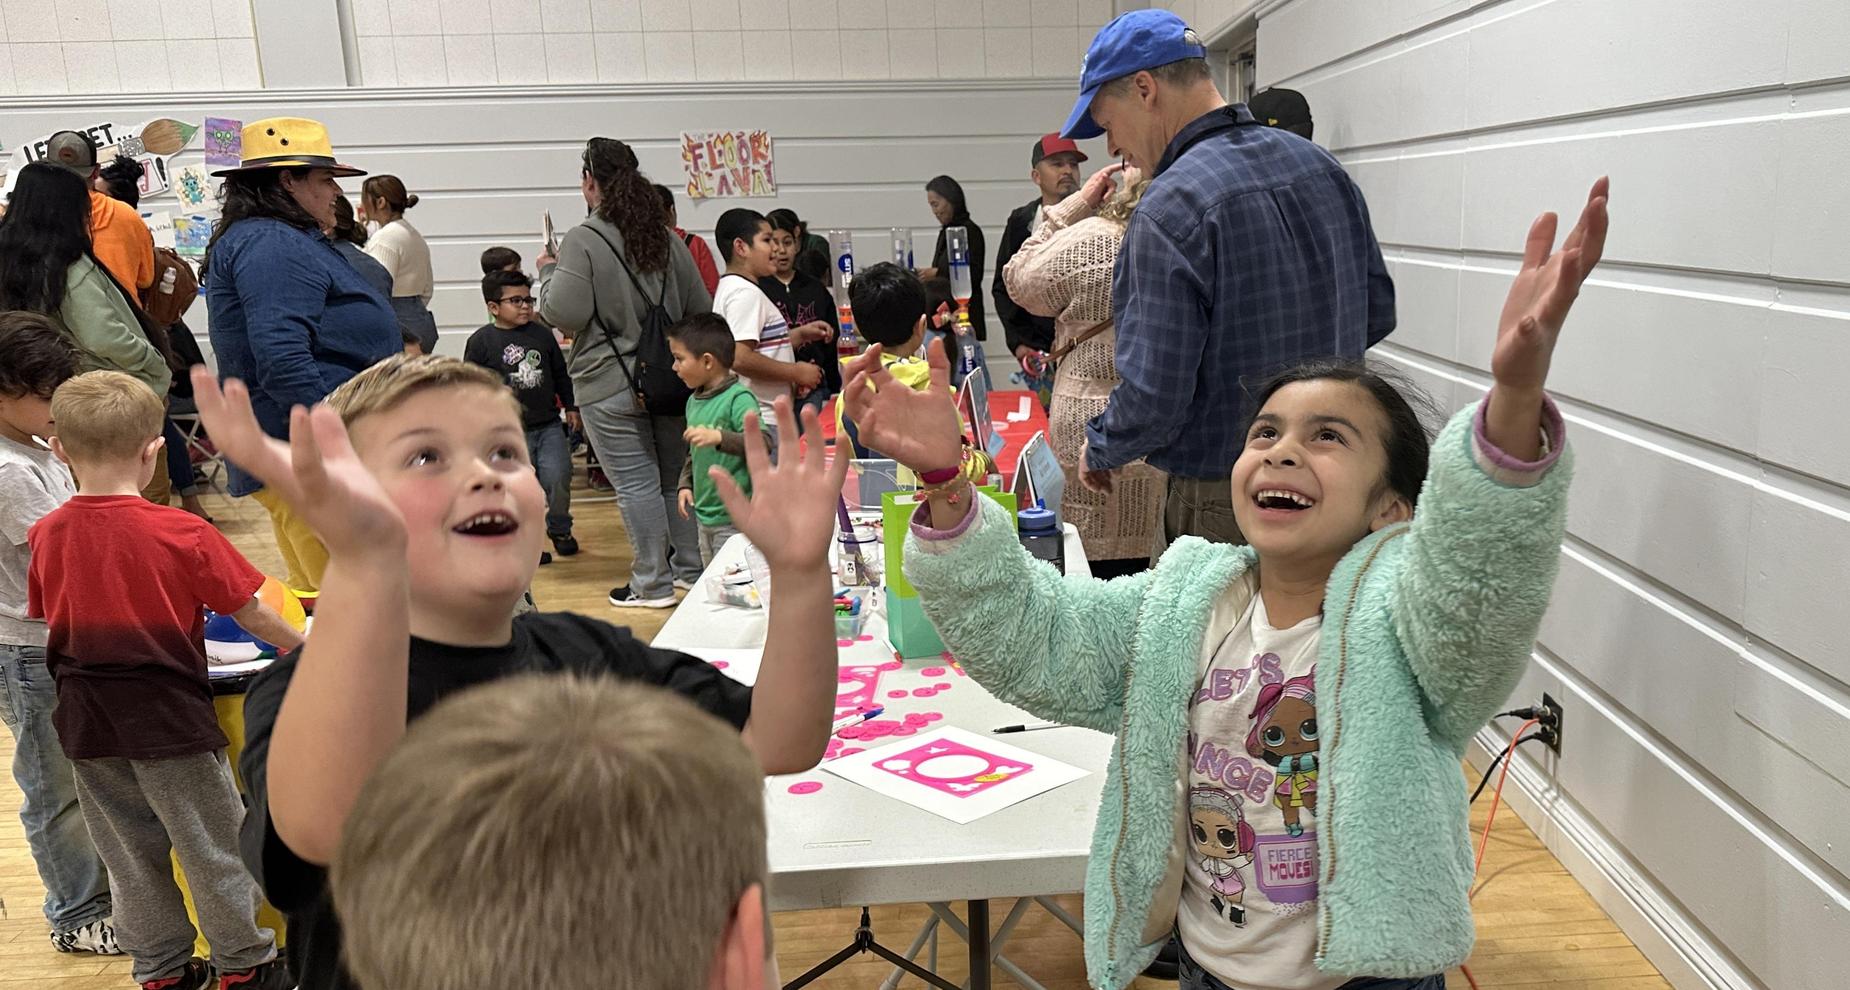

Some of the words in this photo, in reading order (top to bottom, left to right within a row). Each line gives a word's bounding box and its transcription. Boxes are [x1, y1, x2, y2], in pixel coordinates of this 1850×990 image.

[690, 131, 769, 172] FLOOR
[1268, 847, 1312, 862] FIERCE
[1269, 860, 1314, 880] MOVES!
